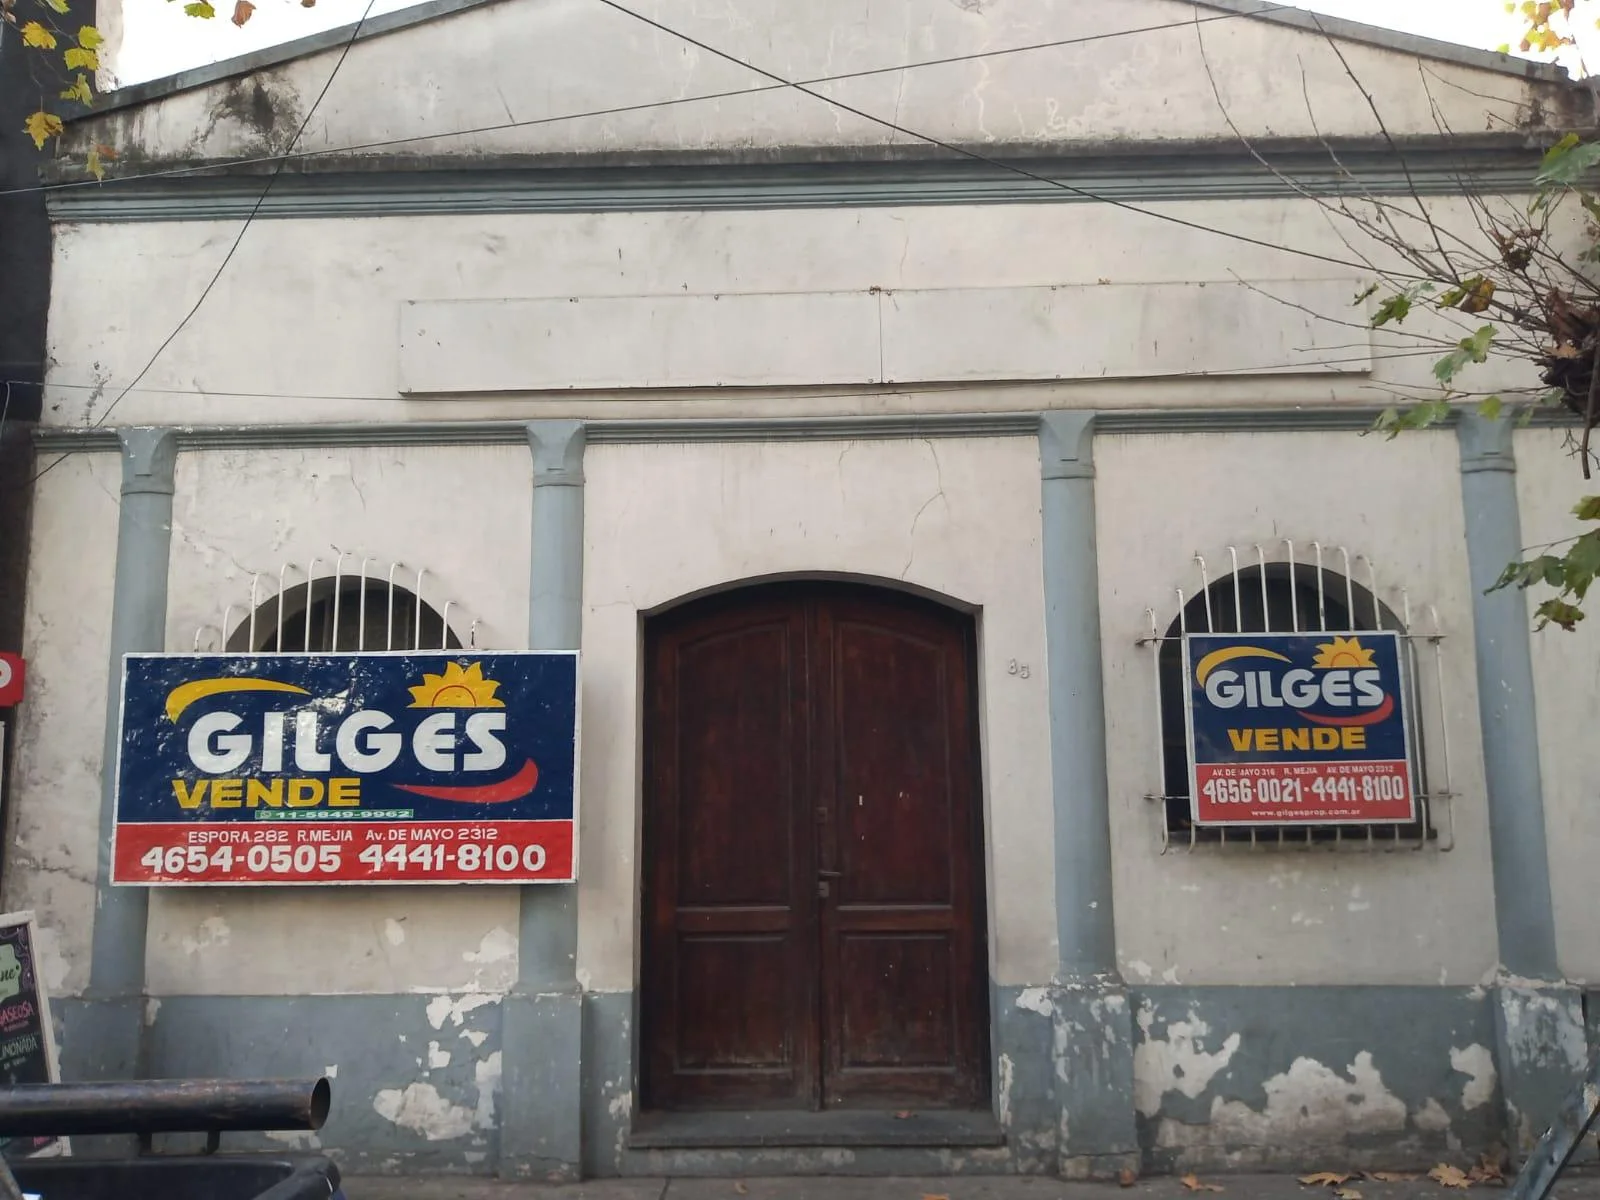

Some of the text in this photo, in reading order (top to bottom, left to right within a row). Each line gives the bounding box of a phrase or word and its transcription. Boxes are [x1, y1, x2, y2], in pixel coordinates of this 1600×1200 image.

[1205, 668, 1385, 709] GILGES
[187, 711, 508, 774] GILGES
[1227, 726, 1367, 752] VENDE
[1225, 768, 1237, 777] DE
[1351, 765, 1374, 773] MAYO
[172, 777, 361, 809] VENDE
[1251, 809, 1361, 817] www.gilgesprop.com.ar
[388, 829, 407, 841] DE
[410, 828, 454, 841] MAYO
[458, 828, 498, 840] 2312
[141, 844, 546, 874] 4654-0505 4441-8100
[0, 1035, 38, 1060] IMONADA
